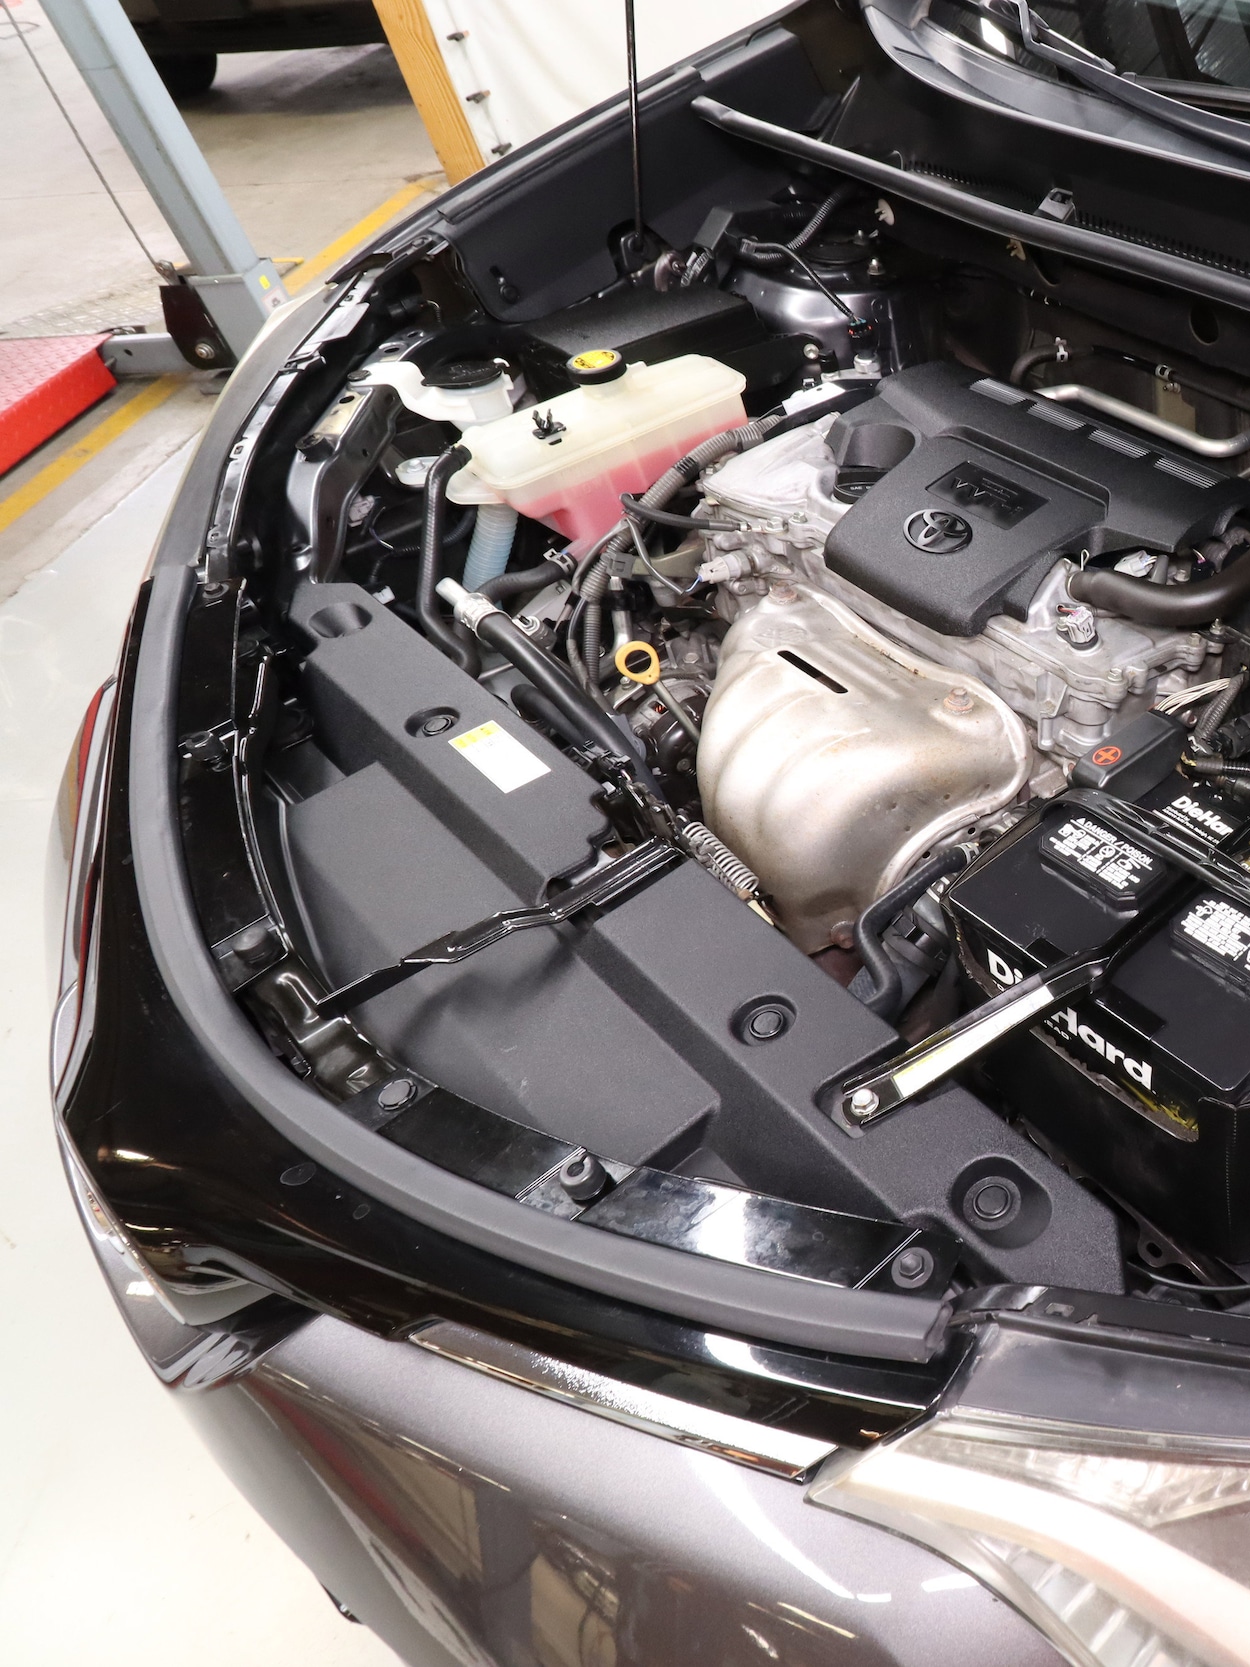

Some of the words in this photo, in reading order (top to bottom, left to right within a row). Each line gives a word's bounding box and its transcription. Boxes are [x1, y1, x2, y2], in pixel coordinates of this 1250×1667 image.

[1171, 795, 1234, 836] DieHar
[1083, 820, 1118, 843] DANGER
[1121, 843, 1153, 865] POISON
